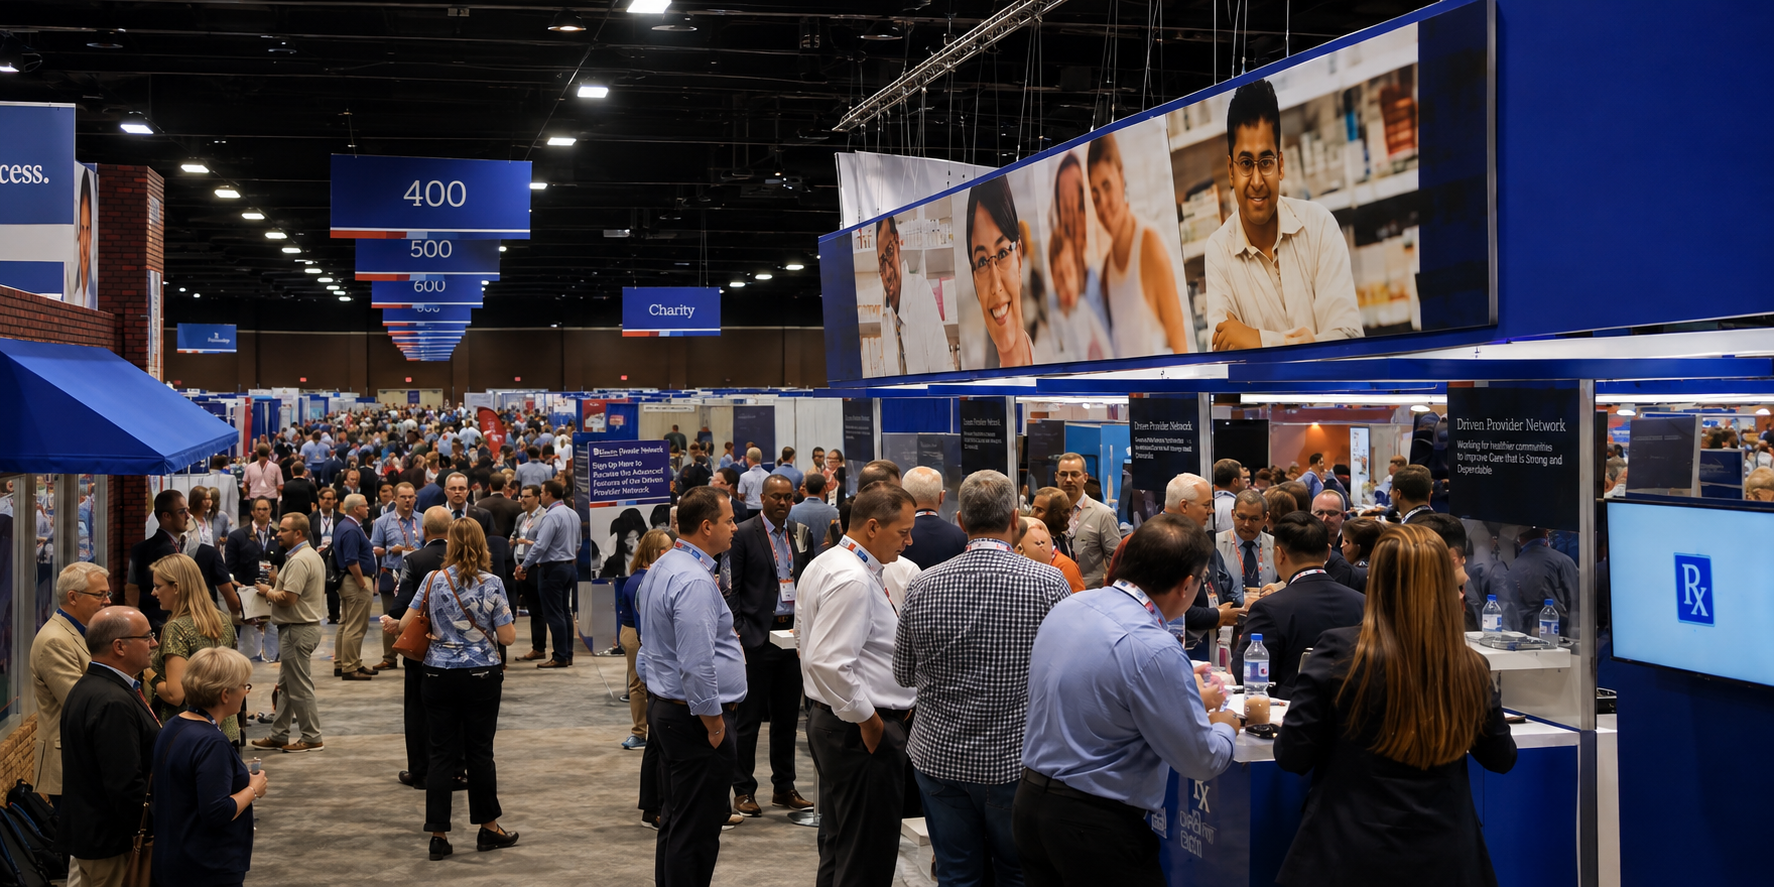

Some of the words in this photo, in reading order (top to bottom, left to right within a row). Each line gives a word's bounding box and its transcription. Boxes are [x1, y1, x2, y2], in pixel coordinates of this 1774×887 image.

[403, 180, 467, 208] 400
[410, 239, 453, 258] 500
[413, 279, 446, 293] 600
[648, 303, 695, 319] Charity
[1456, 417, 1485, 430] Driven
[1486, 417, 1524, 431] Provider
[1525, 418, 1567, 432] Network
[1549, 455, 1563, 466] and
[1681, 563, 1709, 617] Rx
